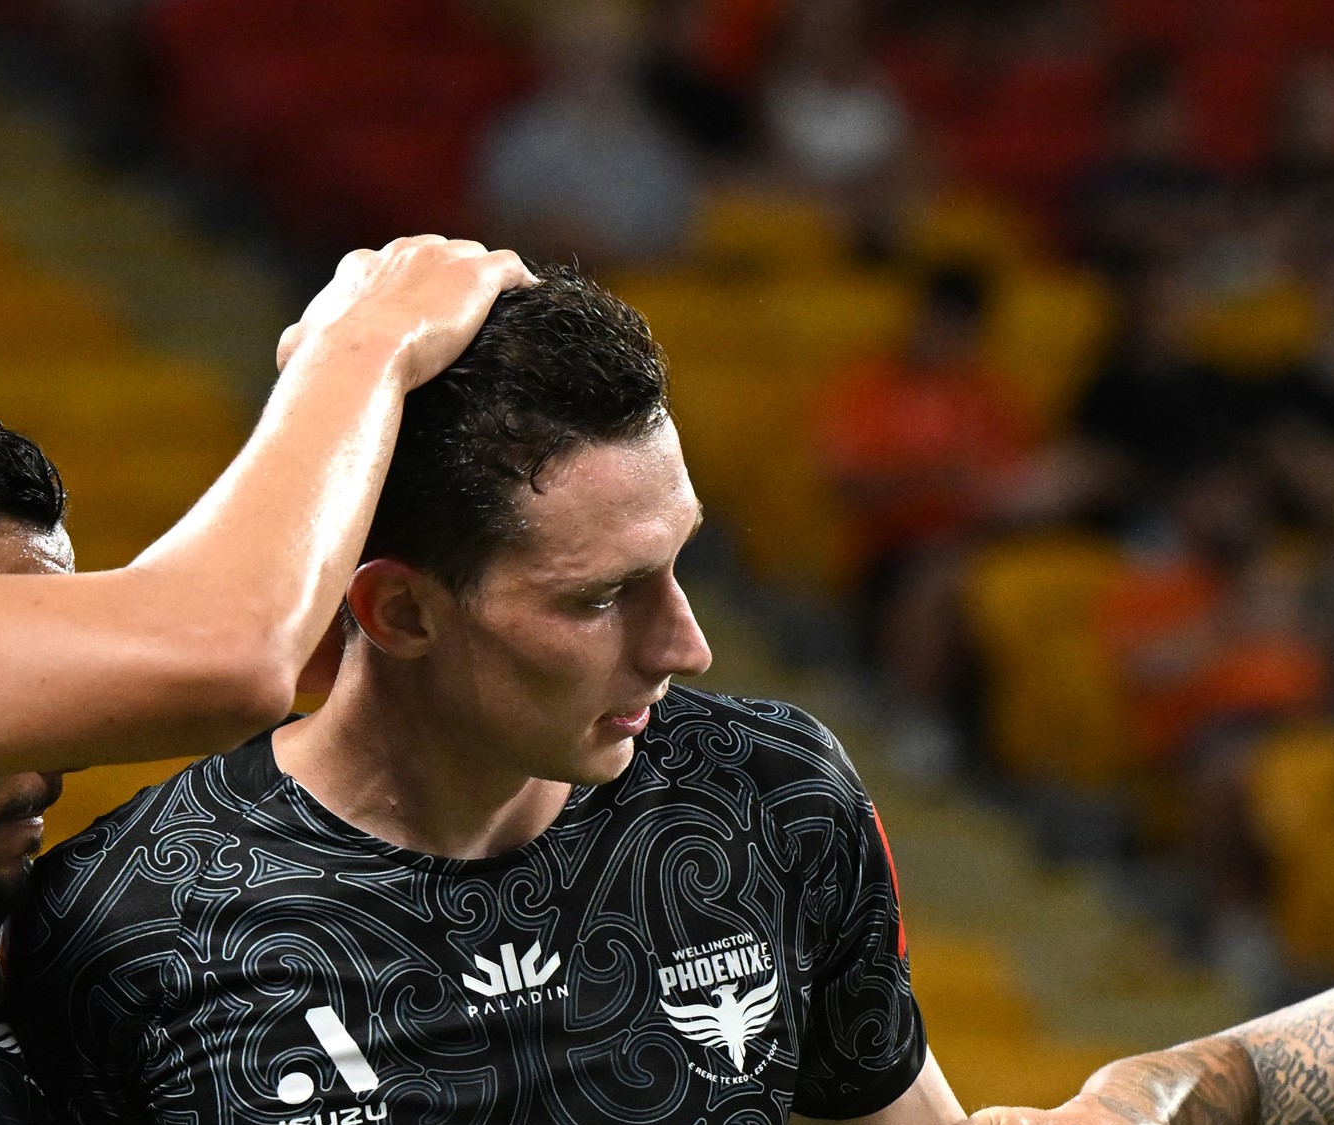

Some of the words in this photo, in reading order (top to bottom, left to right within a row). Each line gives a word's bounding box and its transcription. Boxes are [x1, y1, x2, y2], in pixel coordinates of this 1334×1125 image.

[672, 932, 754, 961] WELLINGTON
[658, 945, 765, 996] PHOENIX
[468, 984, 569, 1018] PALADIN
[695, 1067, 718, 1082] RERE
[720, 1076, 731, 1085] TE
[732, 1074, 749, 1084] KEO
